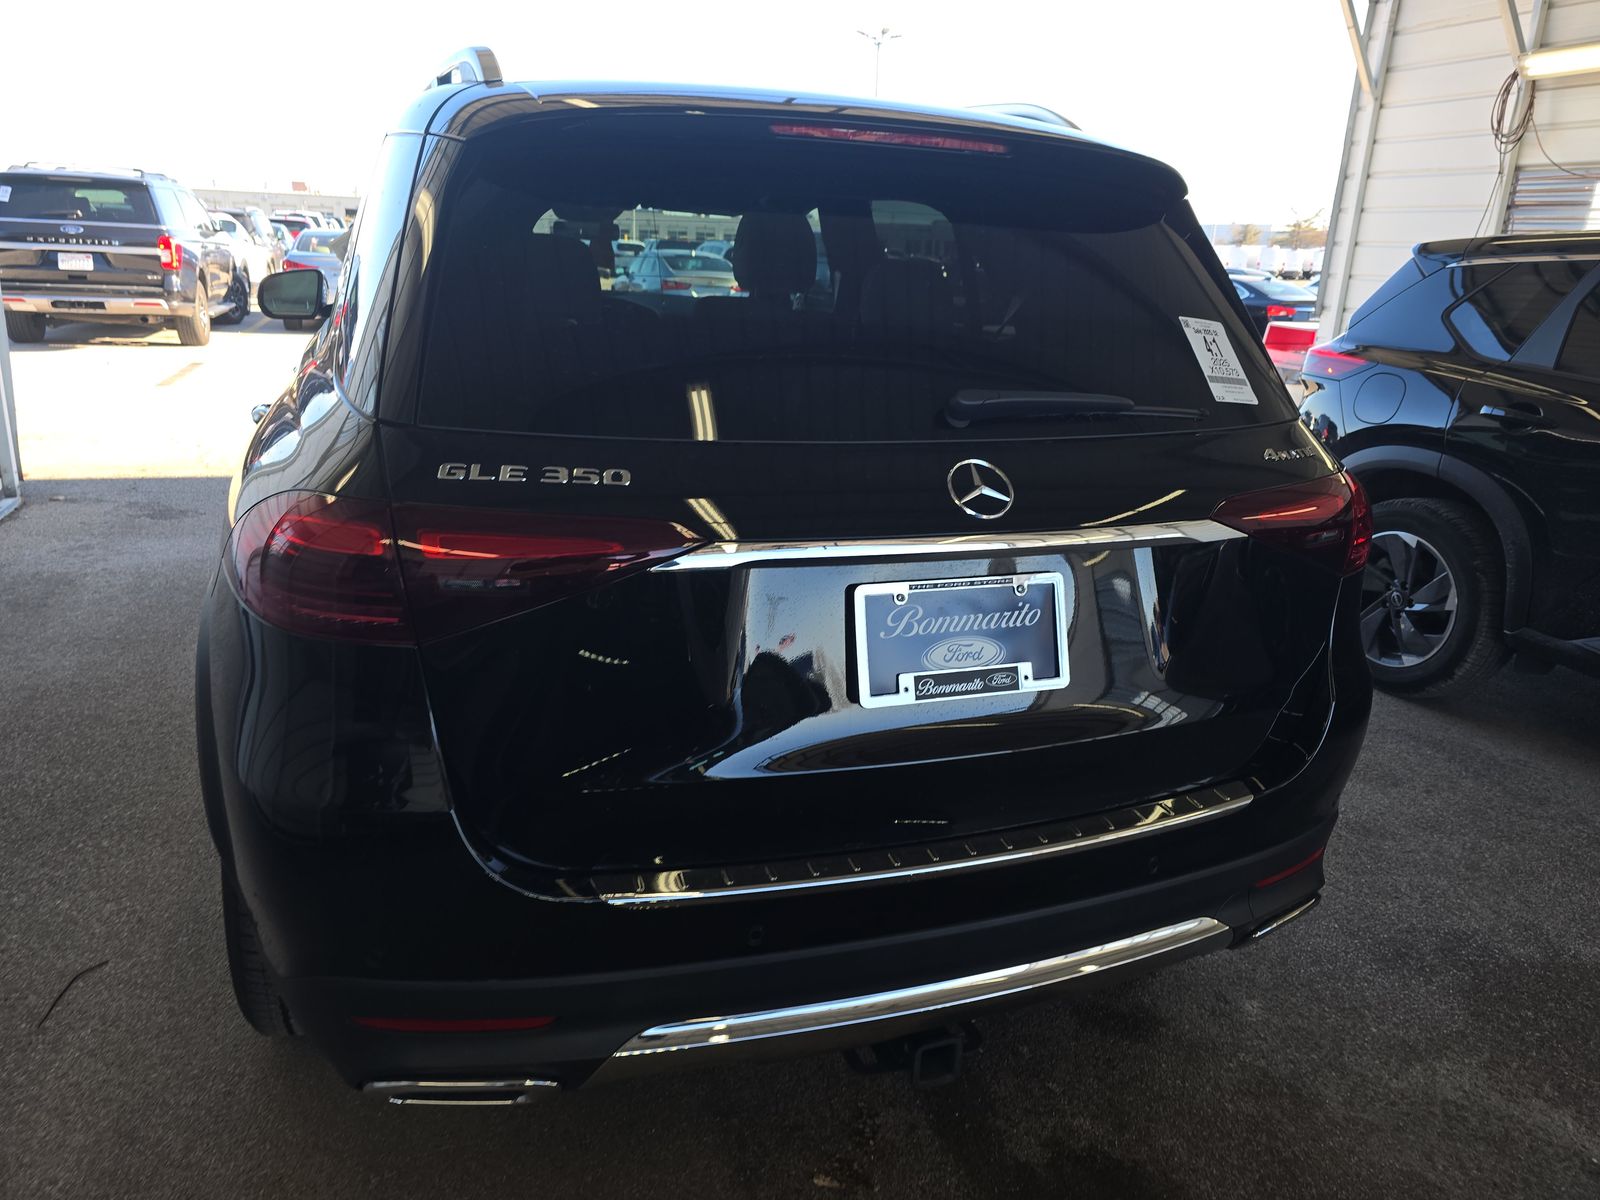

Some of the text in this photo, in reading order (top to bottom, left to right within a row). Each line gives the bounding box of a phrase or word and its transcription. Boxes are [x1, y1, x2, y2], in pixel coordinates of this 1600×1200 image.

[437, 462, 631, 486] GLE 350
[974, 578, 1012, 586] STORE
[879, 601, 1041, 639] Bommarito
[943, 642, 984, 663] Ford
[916, 672, 1012, 696] Bommarito Ford
